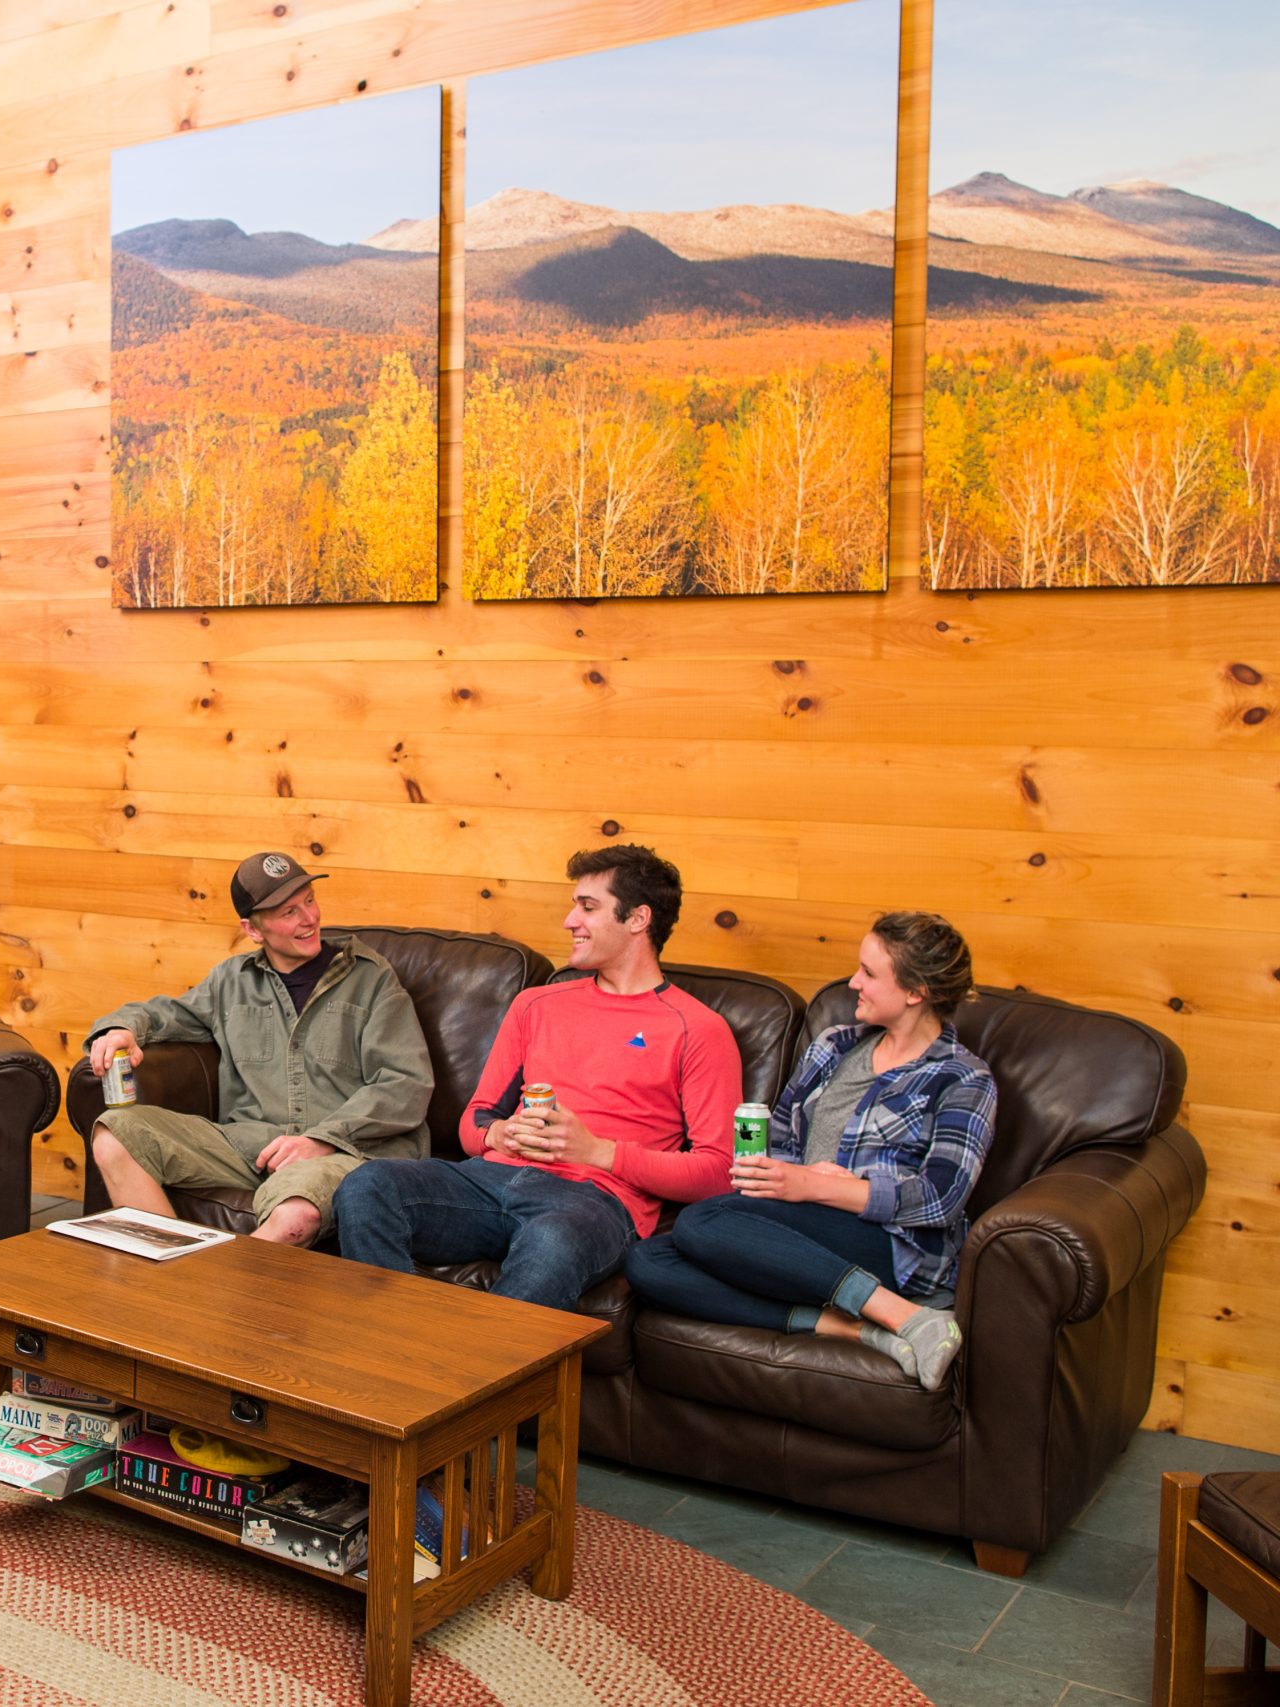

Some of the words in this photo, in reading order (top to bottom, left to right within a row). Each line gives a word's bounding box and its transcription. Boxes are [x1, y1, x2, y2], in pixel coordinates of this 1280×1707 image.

[0, 1405, 42, 1430] MAINE
[79, 1416, 109, 1435] 1000
[122, 1456, 170, 1487] TRUE
[179, 1471, 256, 1506] COLORS
[132, 1482, 143, 1490] YOU
[145, 1485, 155, 1494] SEE
[157, 1489, 186, 1503] YOURSELF
[224, 1507, 235, 1516] SEE
